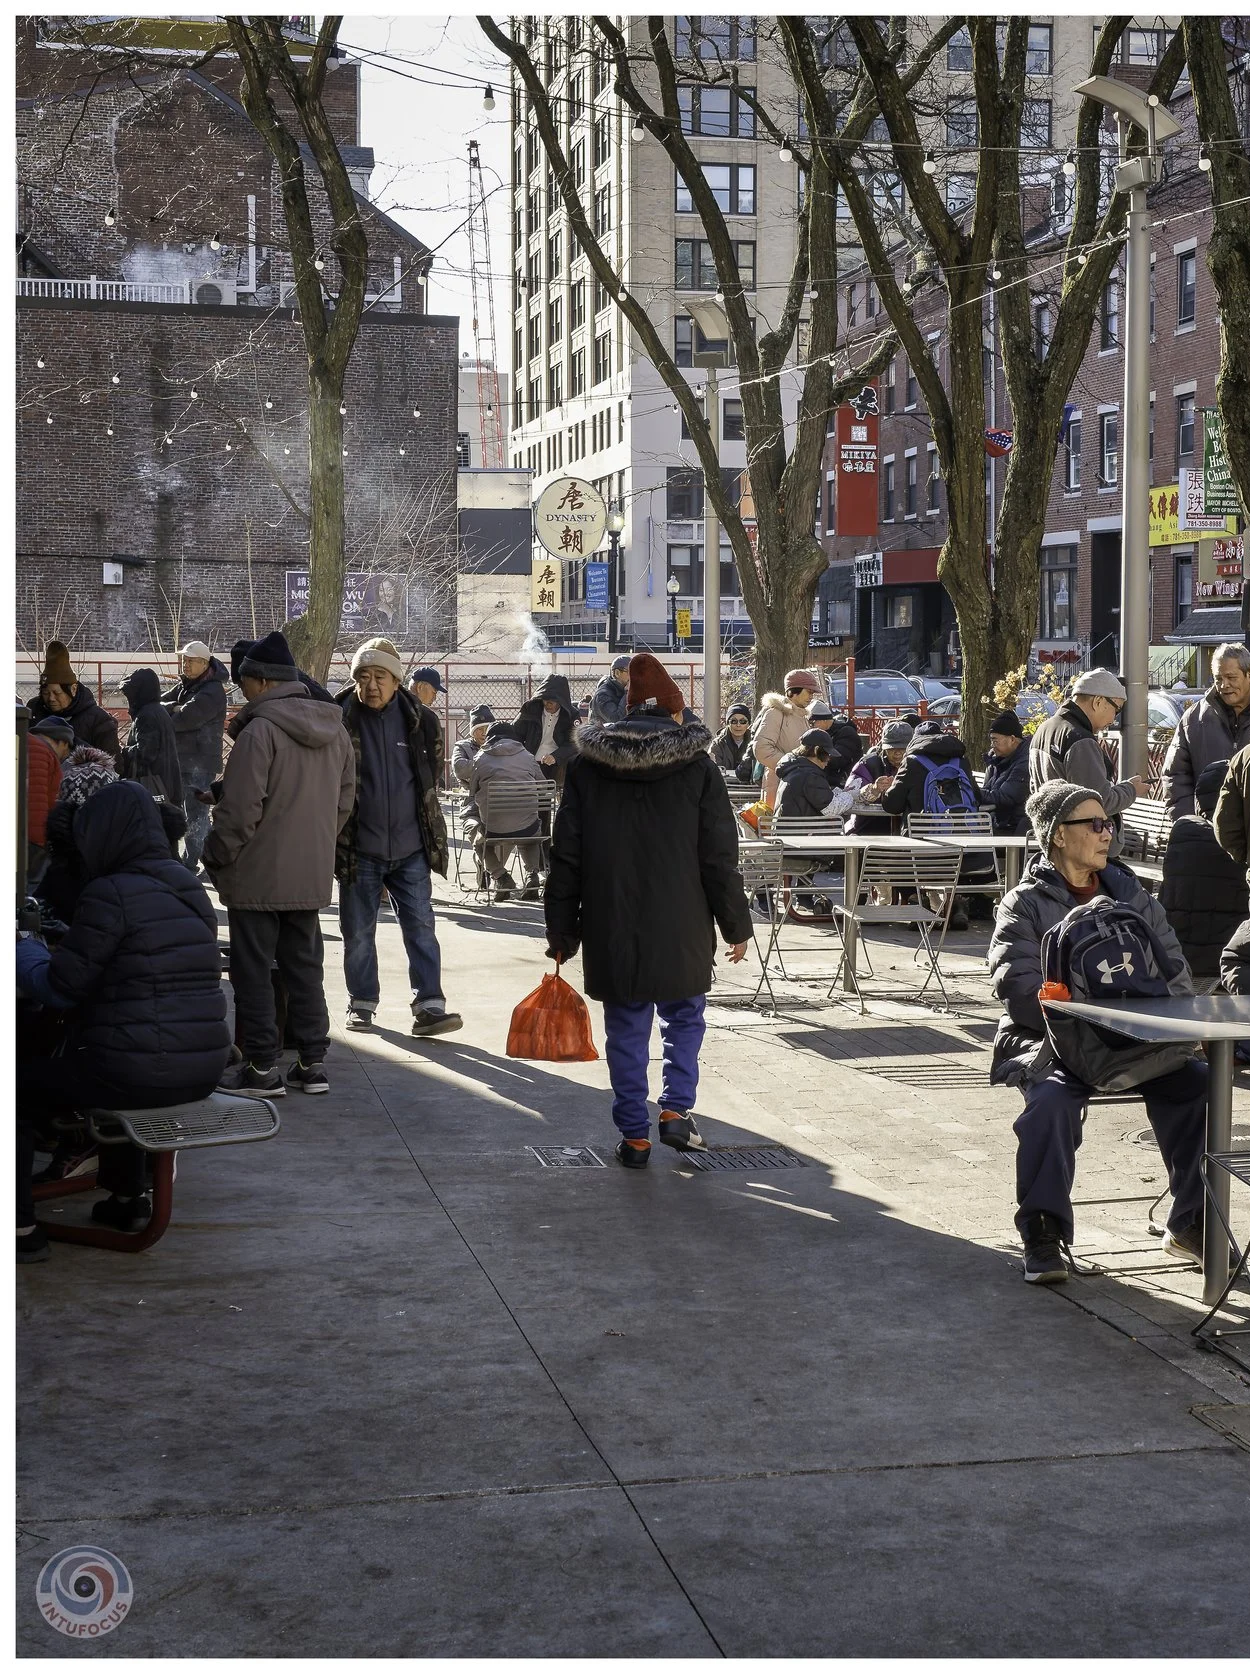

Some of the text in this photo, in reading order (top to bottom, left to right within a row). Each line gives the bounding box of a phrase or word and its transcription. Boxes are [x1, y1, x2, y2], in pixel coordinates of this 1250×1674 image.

[841, 451, 877, 459] MIKIYA
[1207, 469, 1231, 482] China
[557, 481, 584, 511] 唐
[546, 513, 597, 522] DYNASTY
[558, 525, 583, 555] 朝
[537, 565, 555, 608] 唐朝
[1196, 582, 1213, 596] New
[1215, 580, 1239, 597] Wings
